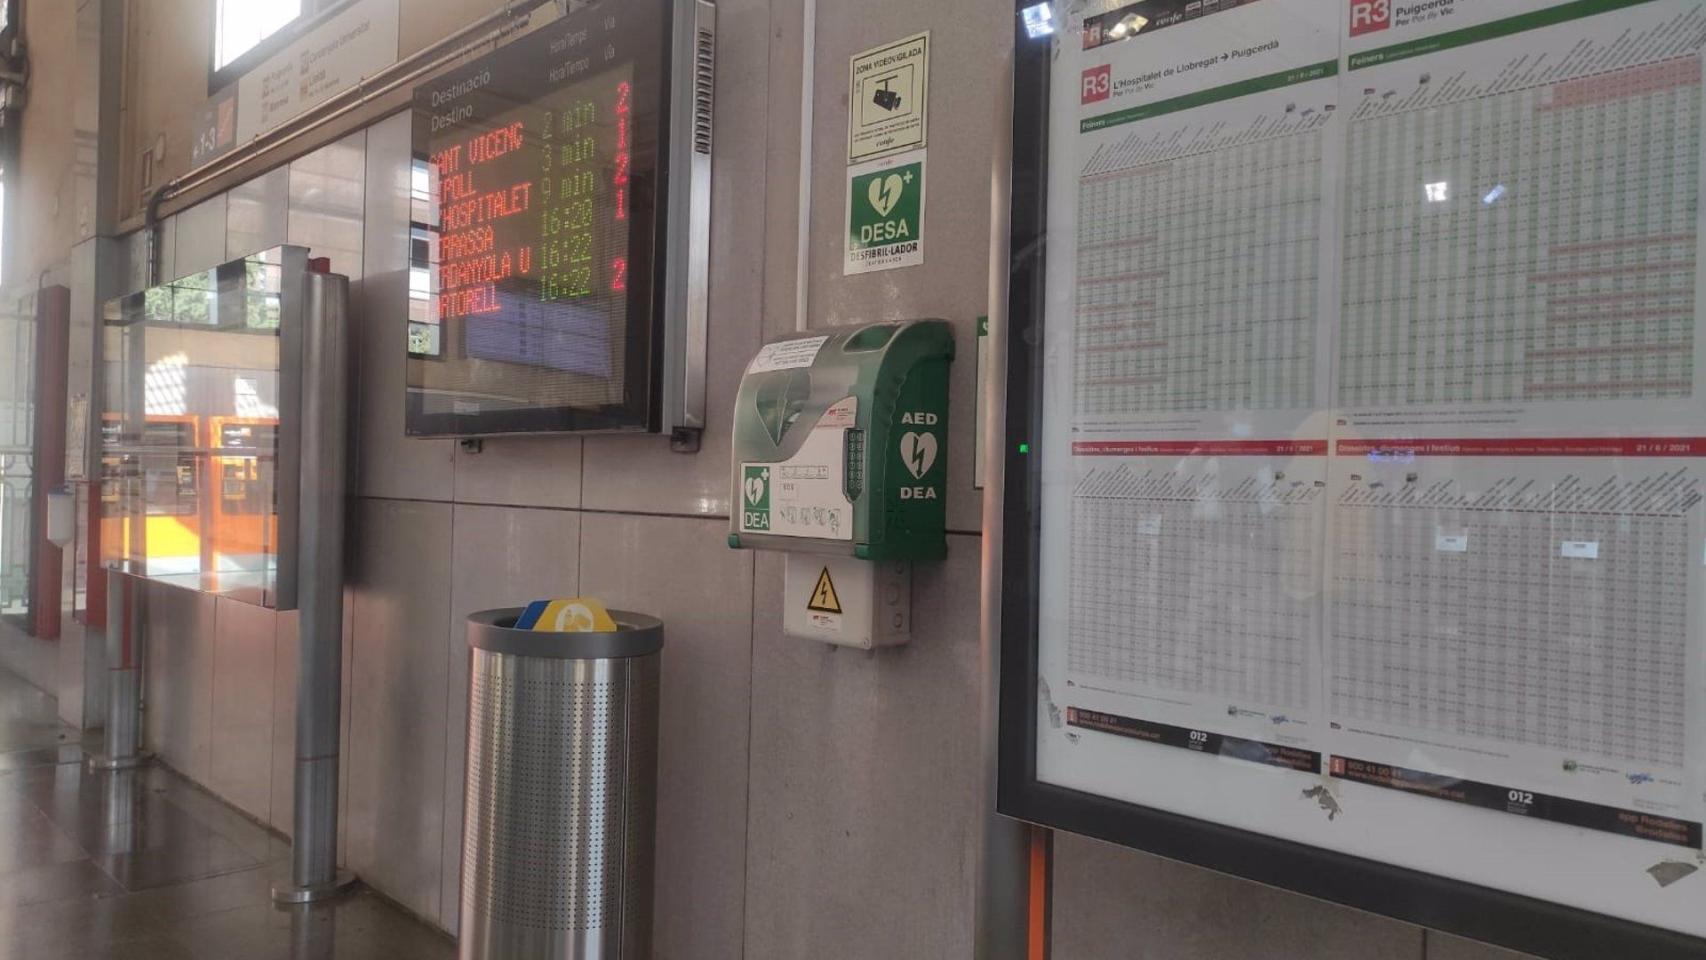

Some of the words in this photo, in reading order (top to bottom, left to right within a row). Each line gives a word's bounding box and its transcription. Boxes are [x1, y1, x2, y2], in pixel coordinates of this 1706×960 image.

[1352, 0, 1390, 28] R3
[856, 64, 873, 75] ZONA
[873, 47, 922, 70] VIDEOVIGILADA
[1113, 70, 1162, 90] L'Hospitalet
[1163, 68, 1174, 77] de
[1176, 56, 1218, 74] Llobregat
[1231, 39, 1280, 59] Puigcerdà
[431, 68, 491, 107] Destinació
[1083, 72, 1109, 97] R3
[431, 103, 473, 133] Destino
[562, 99, 596, 132] min
[614, 80, 630, 114] 2
[562, 133, 595, 168] min
[617, 118, 628, 149] 1
[562, 168, 594, 198] min
[614, 153, 630, 186] 2
[541, 199, 593, 237] 16:20
[615, 189, 626, 220] 1
[861, 218, 910, 244] DESA
[541, 232, 593, 269] 16:22
[541, 266, 592, 301] 16:22
[613, 256, 627, 290] 2
[901, 411, 939, 426] AED
[900, 486, 937, 500] DEA
[745, 511, 769, 529] DEA
[1190, 730, 1208, 742] 012
[1507, 789, 1534, 805] 012
